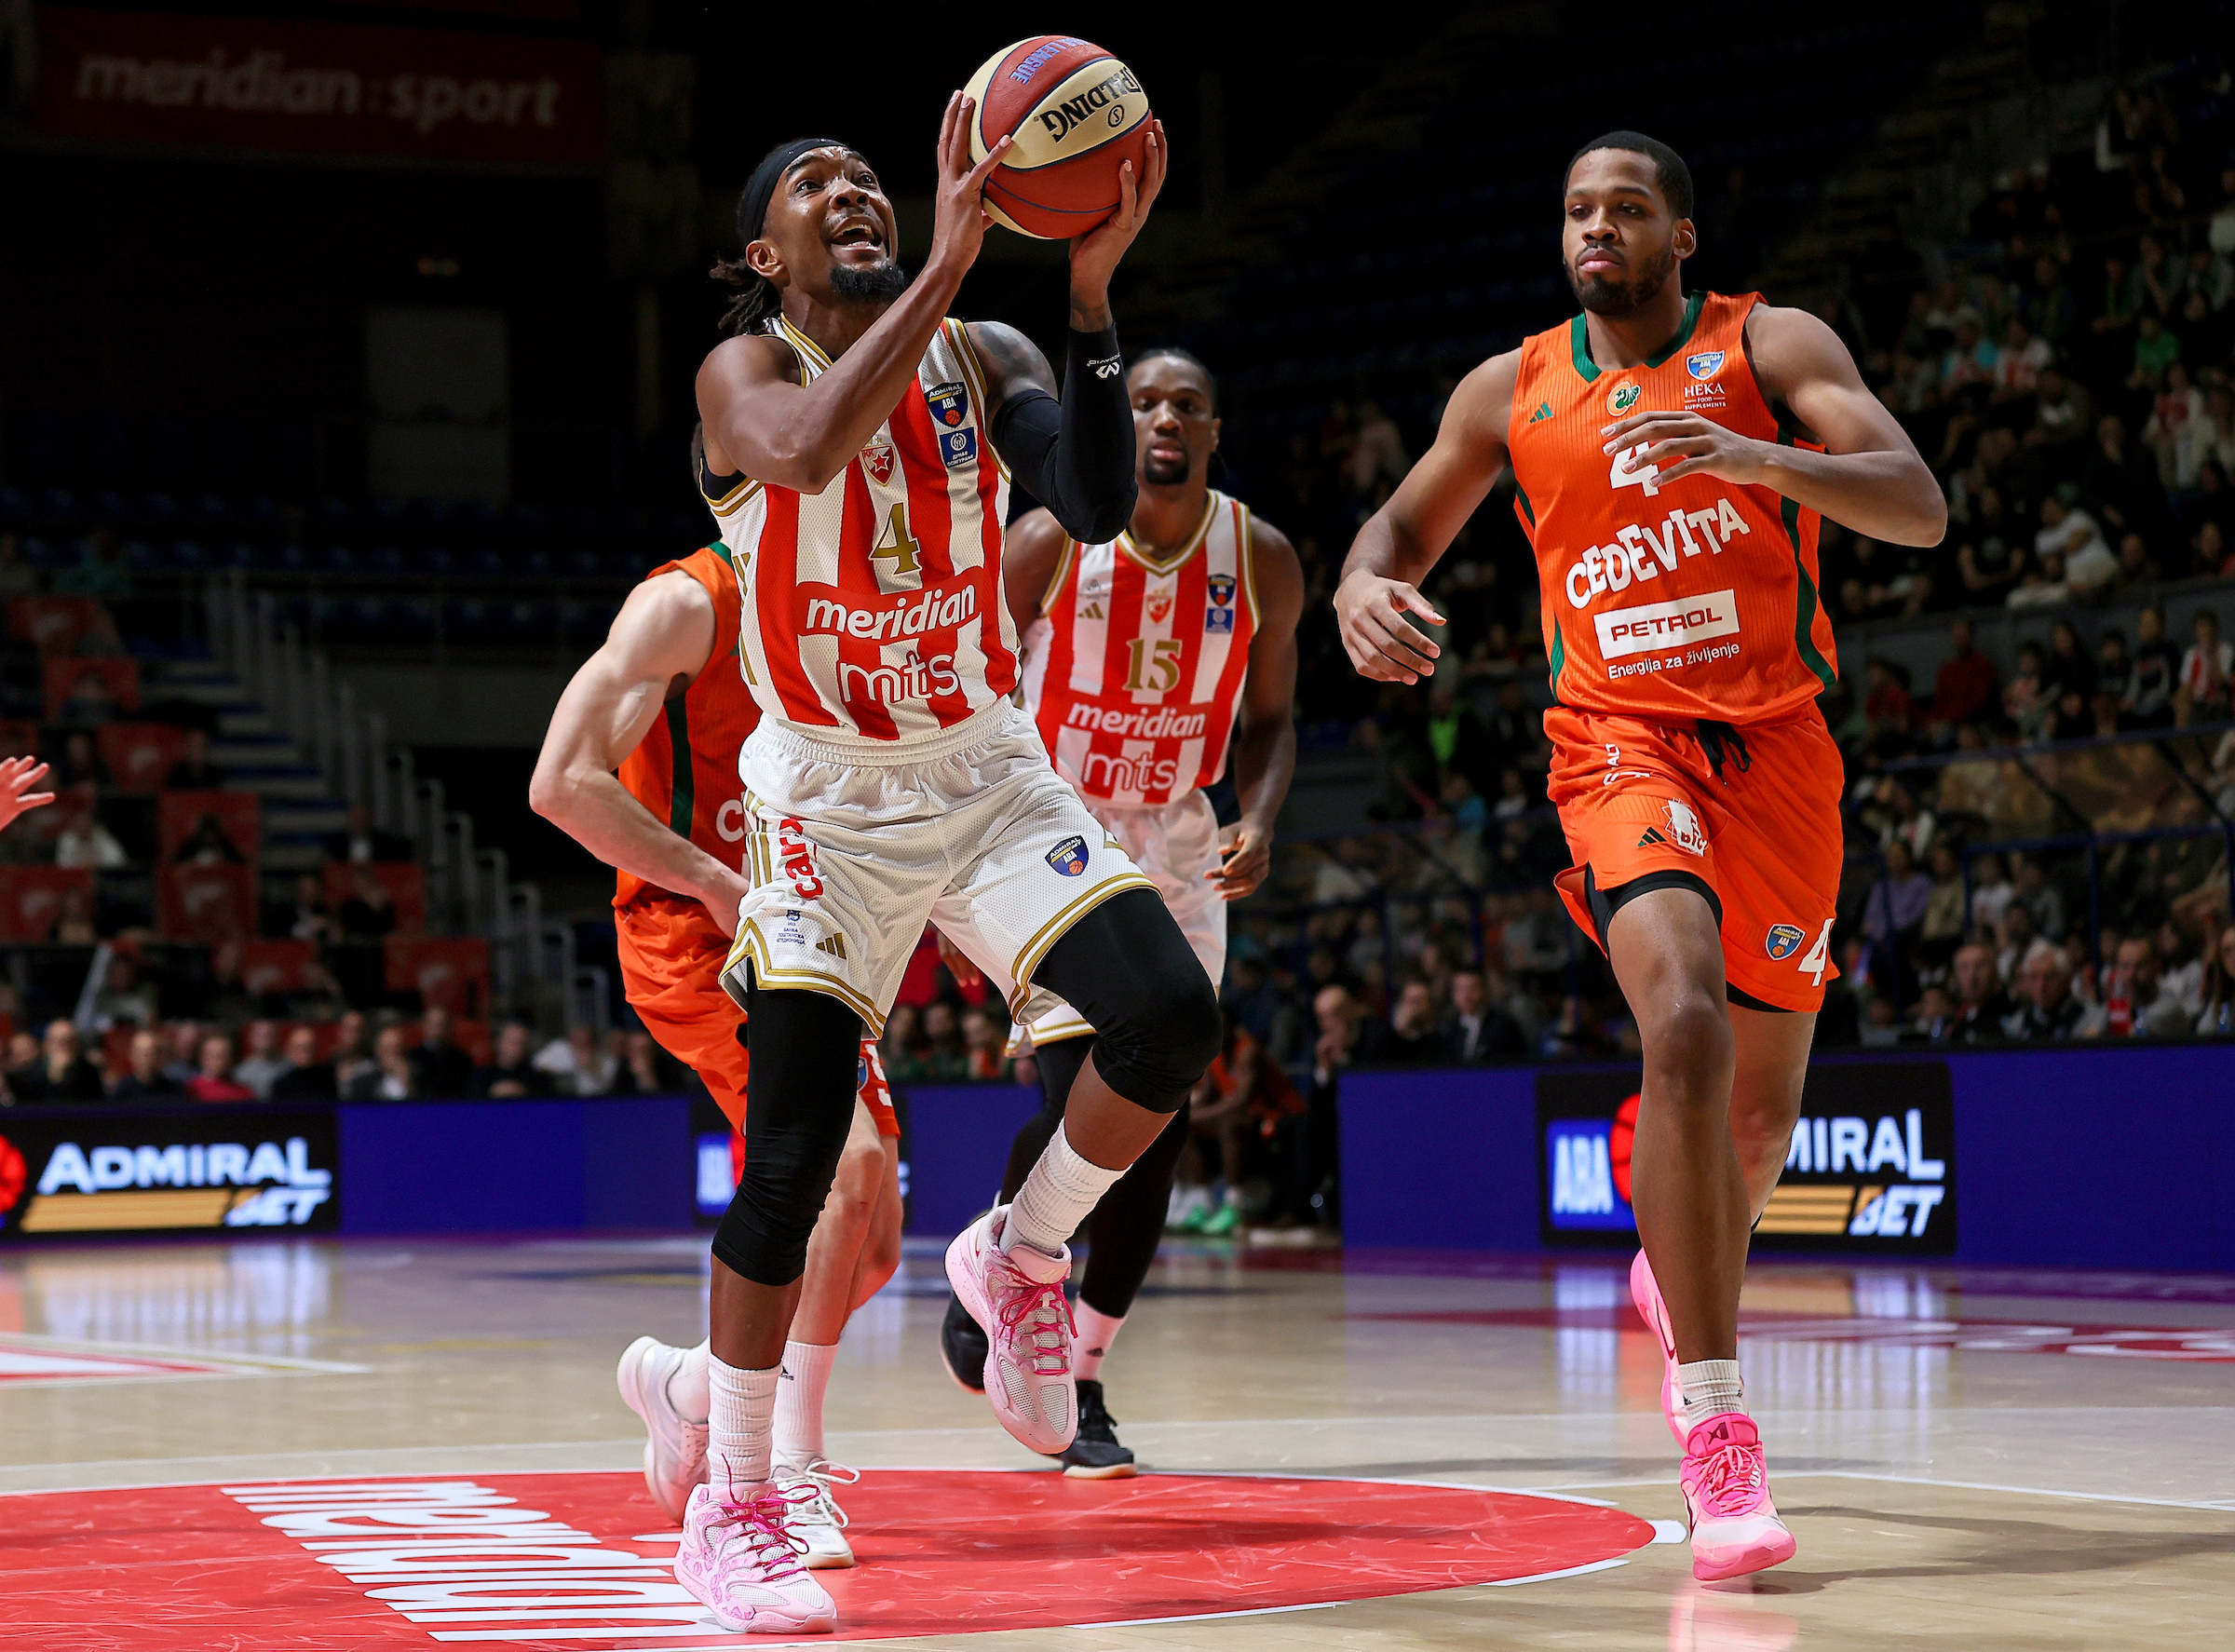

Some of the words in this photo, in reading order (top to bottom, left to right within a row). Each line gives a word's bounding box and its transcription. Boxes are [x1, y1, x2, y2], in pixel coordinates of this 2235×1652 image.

[1009, 42, 1067, 85] LEAGUE
[1039, 66, 1142, 142] PALDING
[928, 384, 963, 399] ADMIRAL
[941, 397, 956, 410] ABA
[1684, 383, 1725, 398] HEKA
[1684, 401, 1727, 411] SUPPLEMENTS
[1609, 441, 1659, 497] 4
[868, 502, 922, 575] 4
[1565, 498, 1751, 609] CEDEVITA
[806, 584, 975, 640] meridian
[1611, 606, 1723, 642] PETROL
[839, 651, 960, 703] mts
[1122, 638, 1183, 693] 15
[1607, 658, 1661, 680] Energija
[1665, 656, 1683, 669] za
[1686, 643, 1741, 665] življenje
[1066, 702, 1206, 738] meridian
[1083, 752, 1176, 792] mts
[1050, 837, 1081, 860] ADMIRAL
[1063, 850, 1078, 864] ABA
[1797, 918, 1835, 986] 4
[35, 1135, 332, 1196] ADMIRAL
[1785, 1107, 1945, 1181] MIRAL
